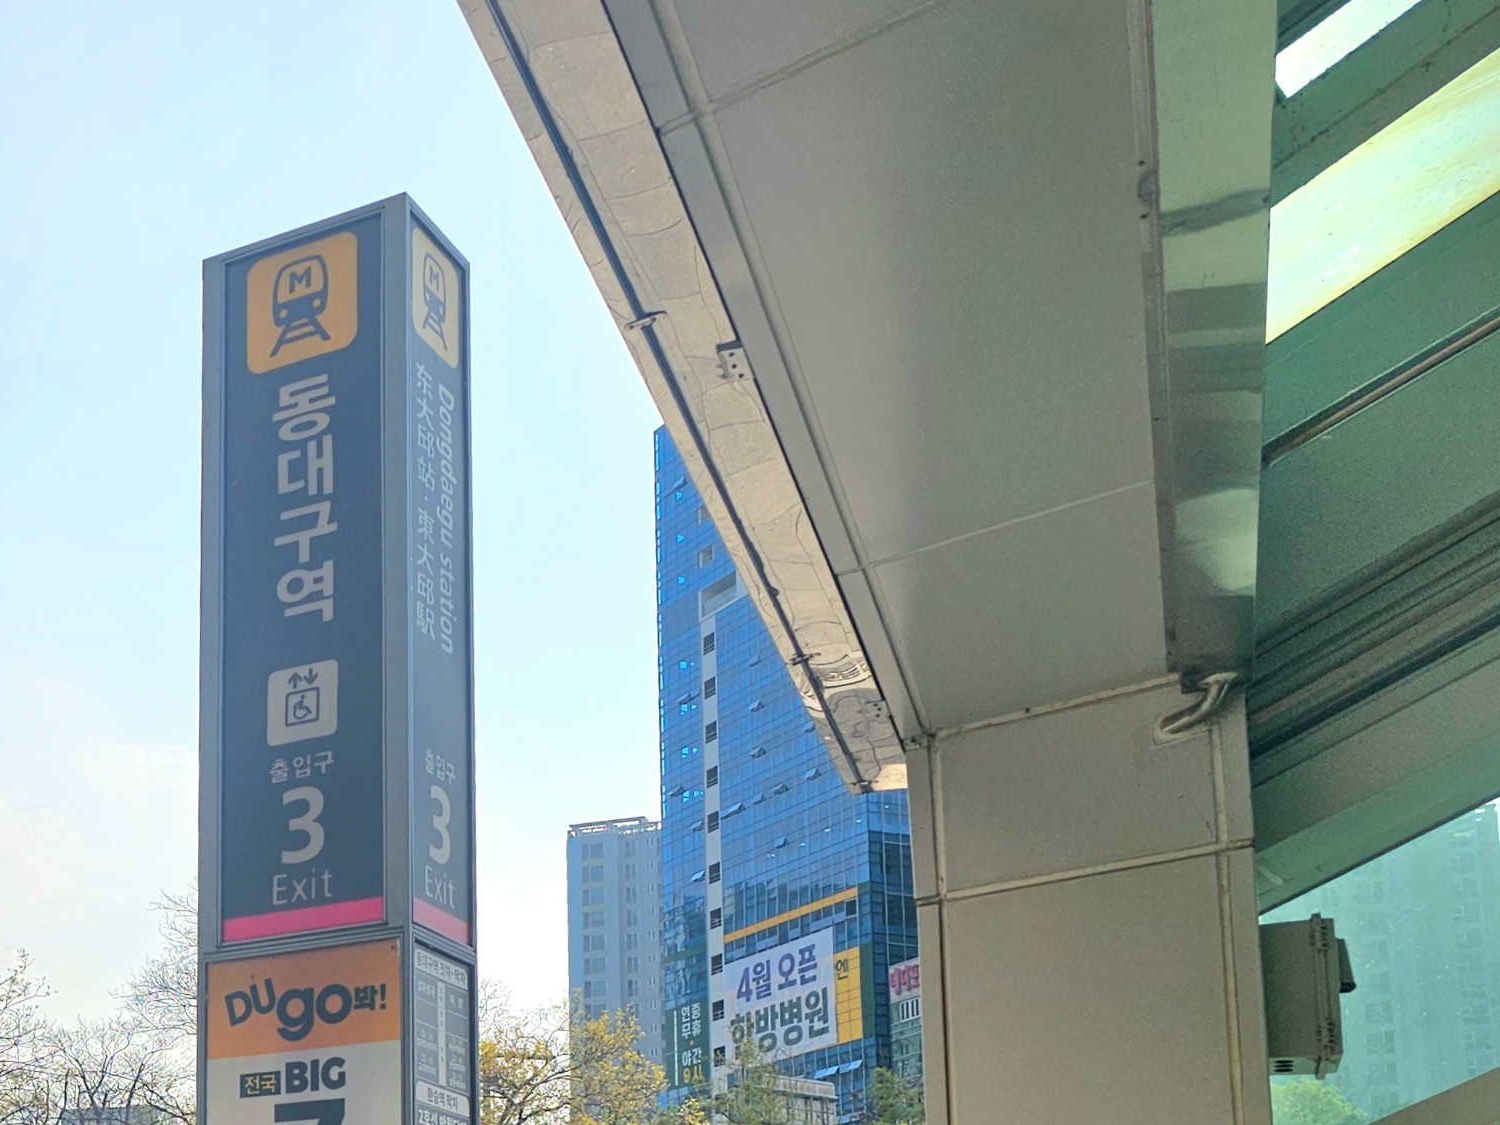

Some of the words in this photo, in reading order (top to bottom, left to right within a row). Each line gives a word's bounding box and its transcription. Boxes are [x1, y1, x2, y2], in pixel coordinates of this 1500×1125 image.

[436, 382, 458, 549] Dongdaegu
[272, 373, 338, 622] 동대구역
[440, 553, 457, 654] station
[269, 751, 334, 784] 출입구
[425, 749, 456, 785] 출입구
[281, 786, 325, 864] 3
[429, 785, 451, 864] 3
[272, 868, 333, 905] Exit
[425, 865, 455, 909] Exit
[736, 958, 772, 1003] 4월
[777, 943, 818, 991] 오픈
[681, 1020, 701, 1039] 무휴
[730, 986, 830, 1053] 한방병원
[245, 1074, 276, 1095] 전국
[285, 1057, 346, 1094] BIG
[682, 1047, 703, 1067] 야간
